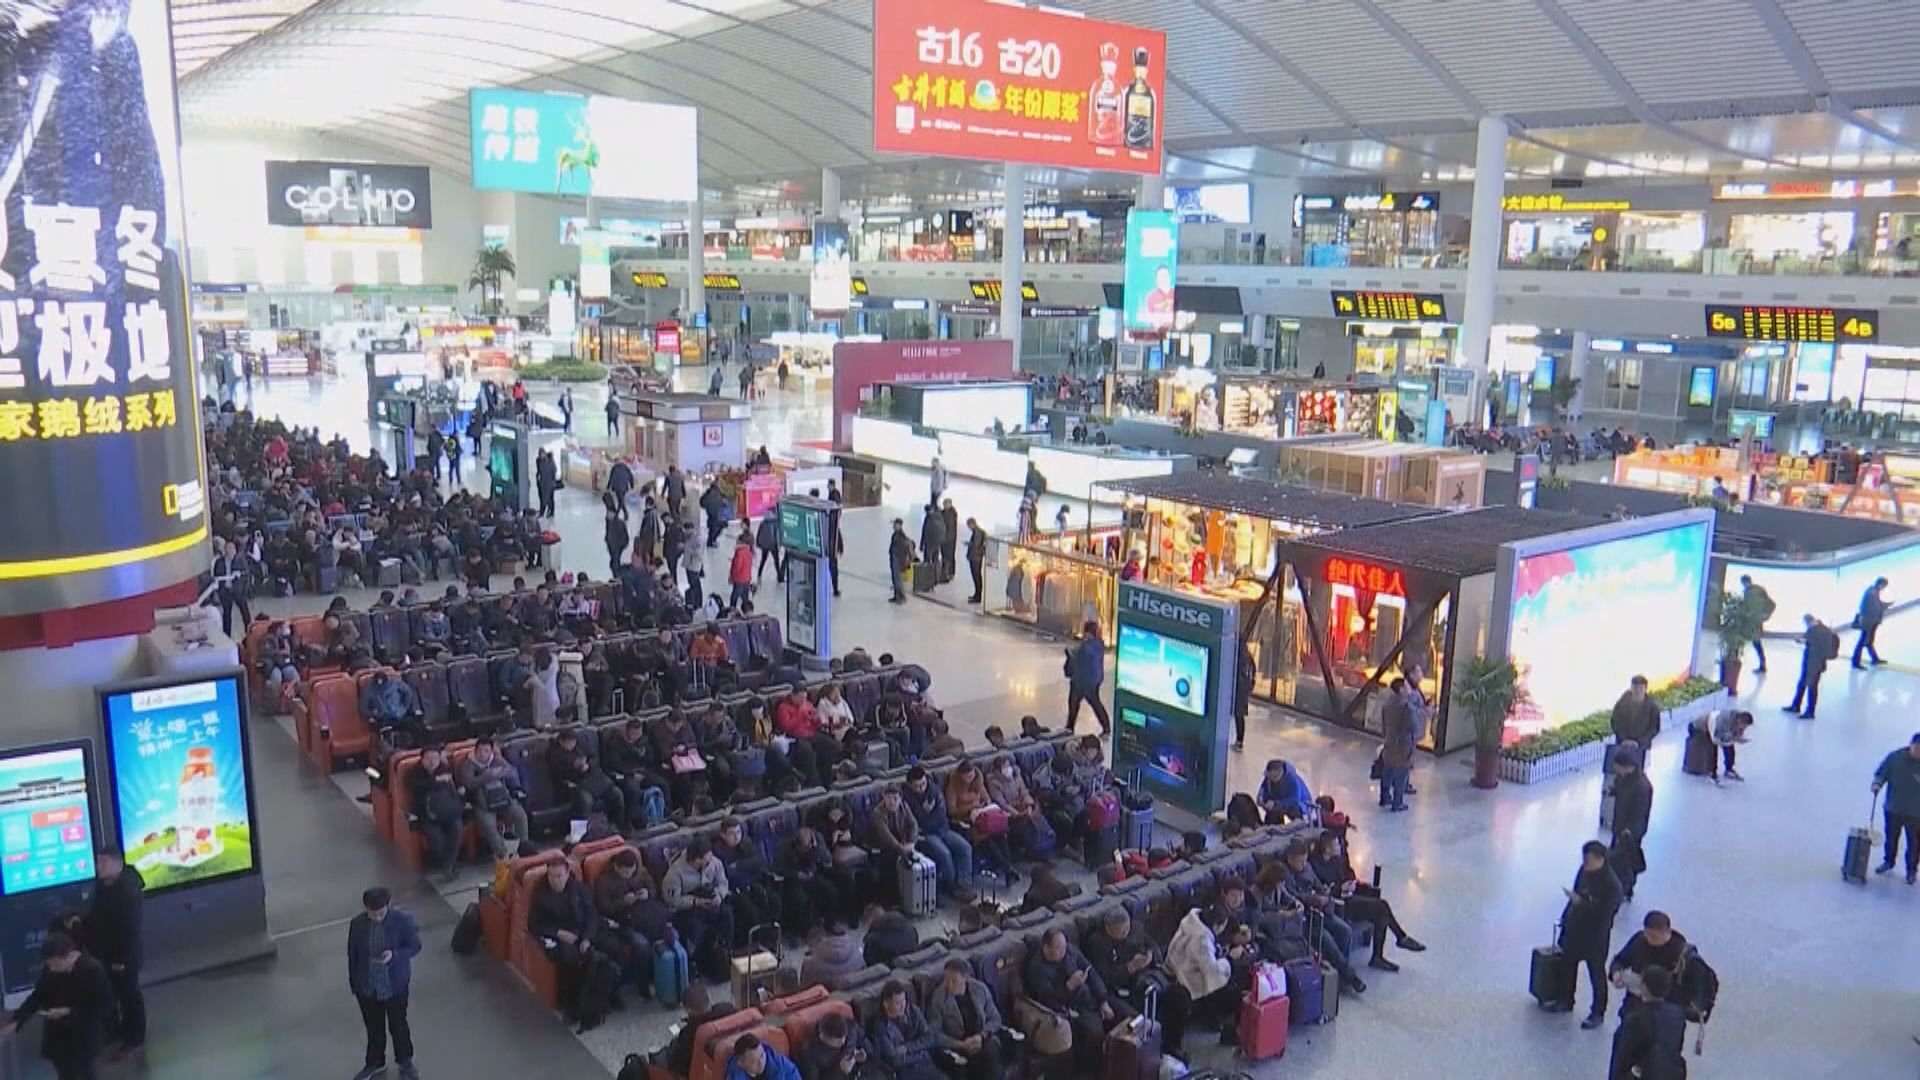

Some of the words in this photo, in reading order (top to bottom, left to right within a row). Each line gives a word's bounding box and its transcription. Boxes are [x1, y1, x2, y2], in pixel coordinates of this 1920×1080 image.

[916, 26, 983, 68] 古16
[998, 38, 1061, 79] 古20
[285, 184, 416, 213] COLMO
[1711, 312, 1737, 331] 5B
[1844, 317, 1873, 337] 4B
[1328, 558, 1405, 597] 绝代佳人
[1129, 589, 1212, 629] Hisense
